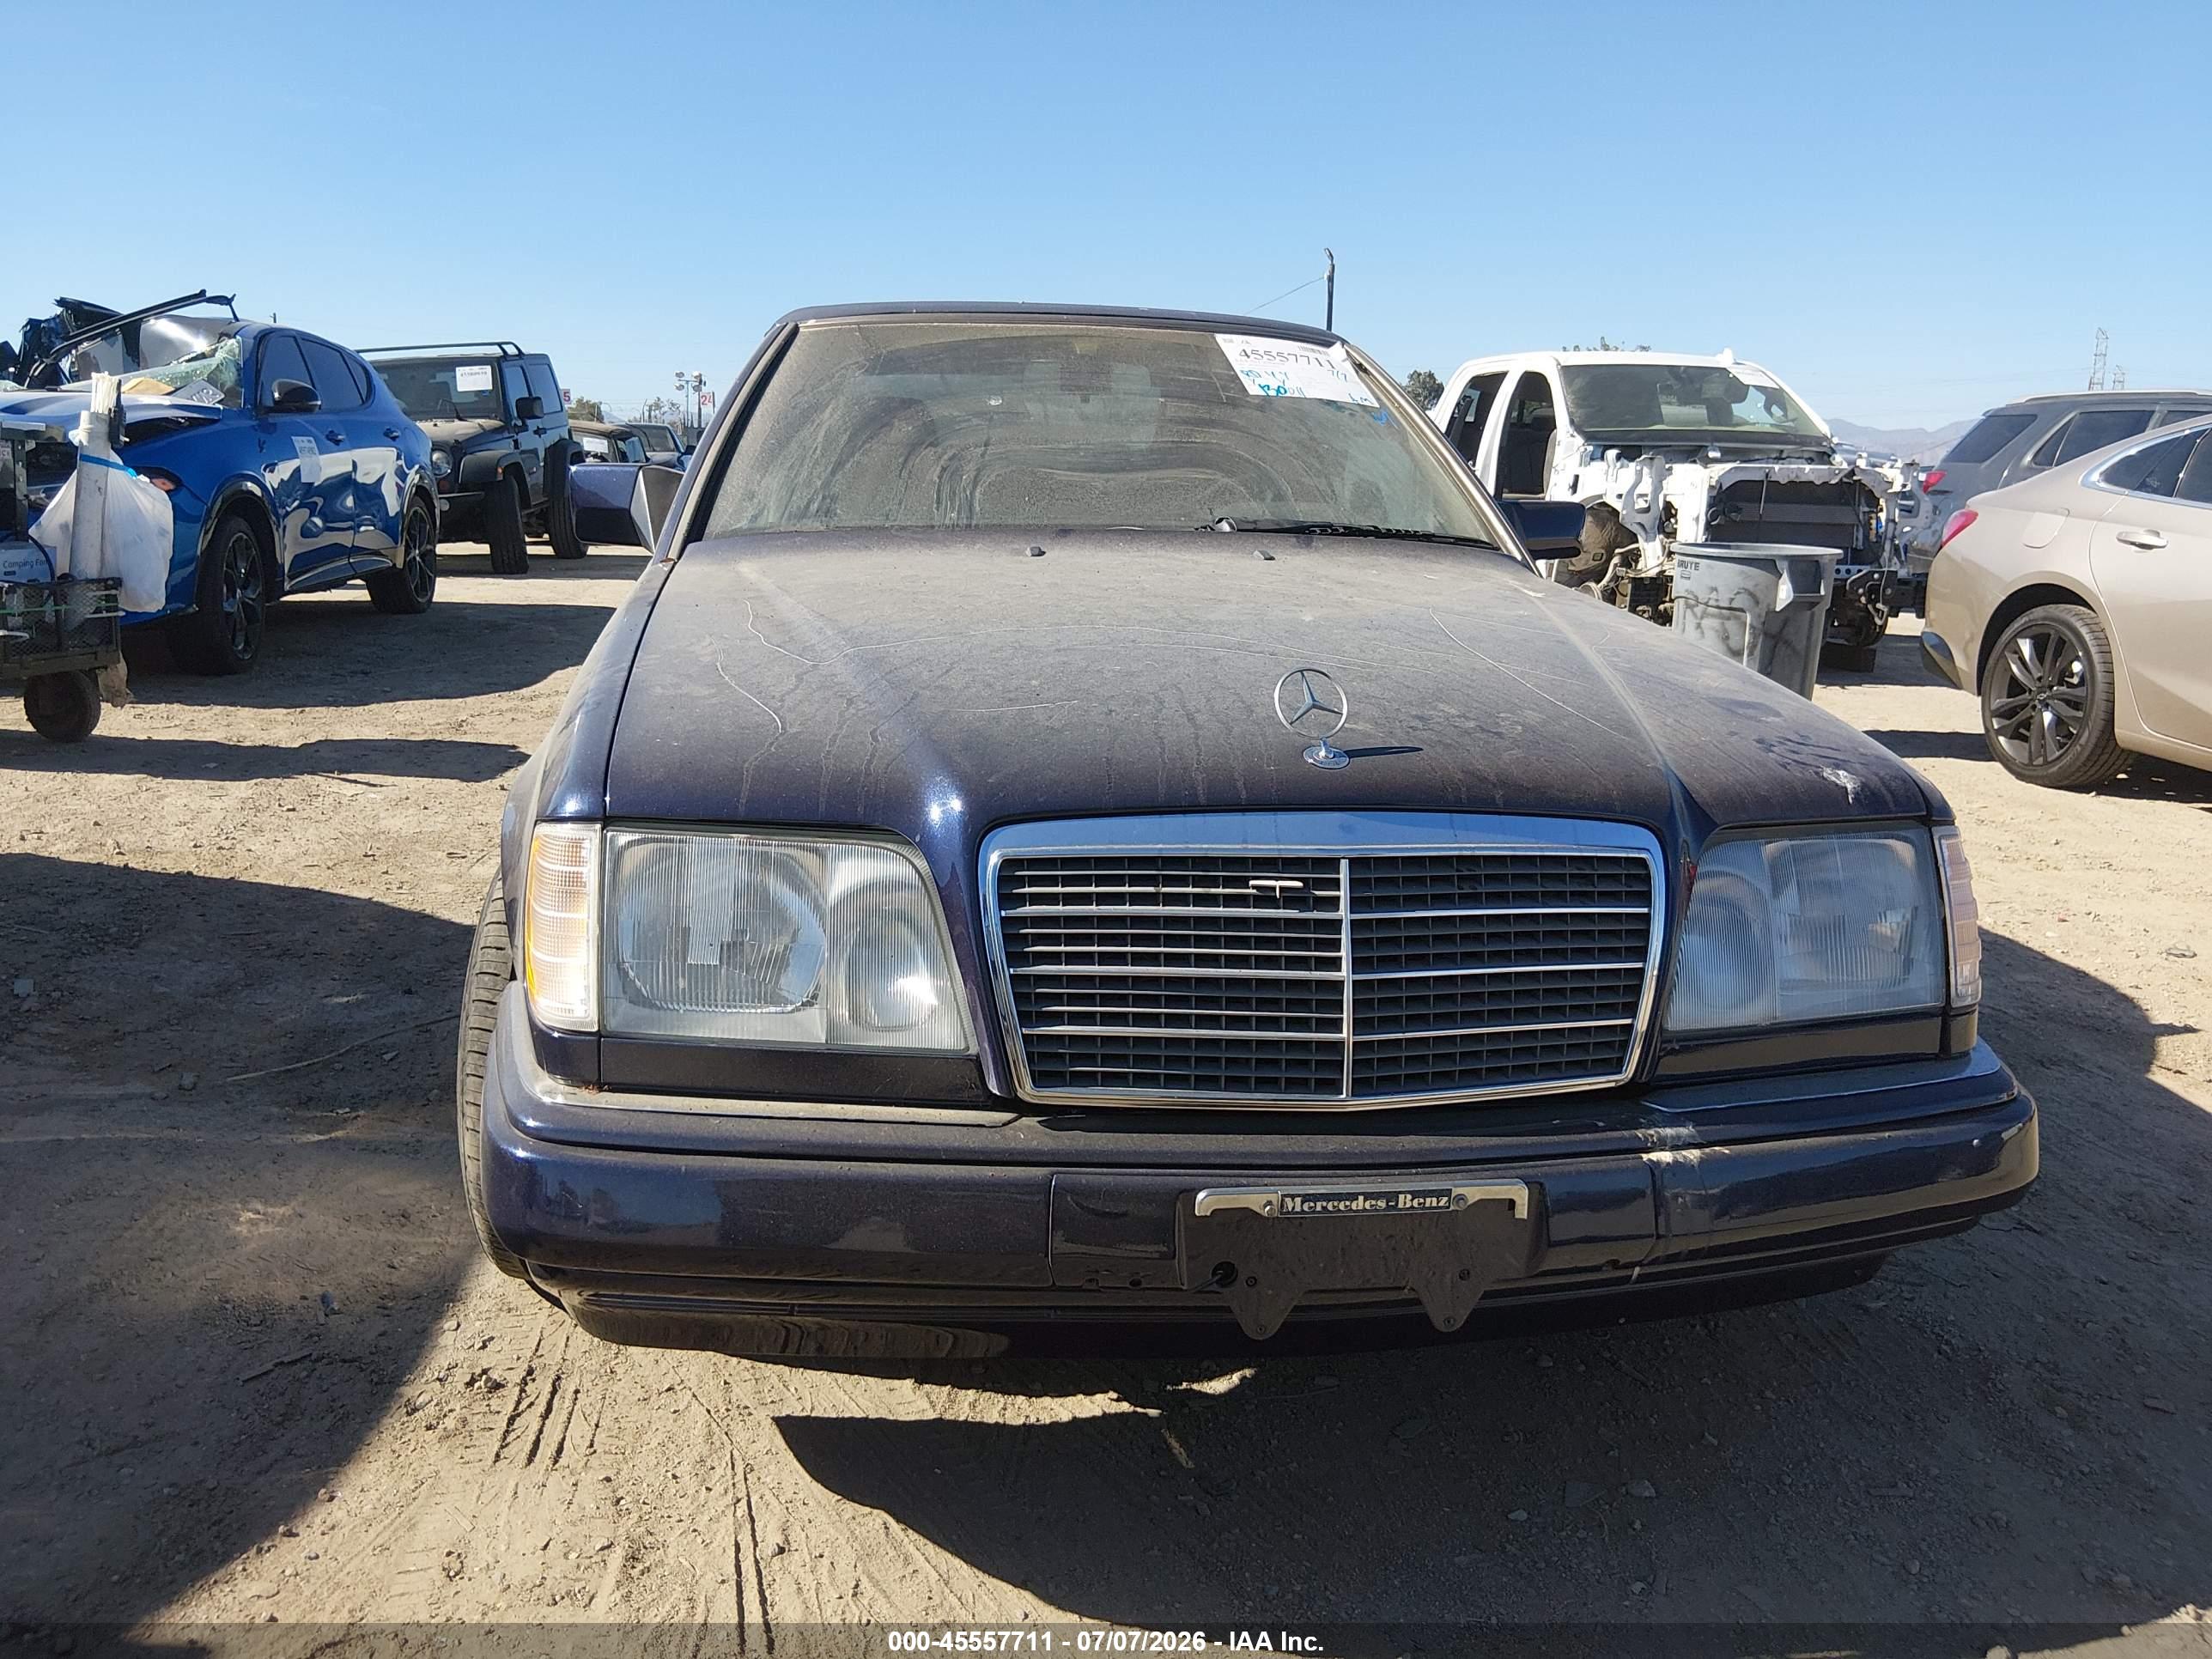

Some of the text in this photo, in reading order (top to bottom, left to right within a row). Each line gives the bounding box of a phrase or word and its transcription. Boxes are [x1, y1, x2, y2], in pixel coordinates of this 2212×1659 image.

[1239, 348, 1335, 369] 45557711
[3, 558, 34, 569] Camping
[1283, 1193, 1449, 1212] Mercedes-Benz
